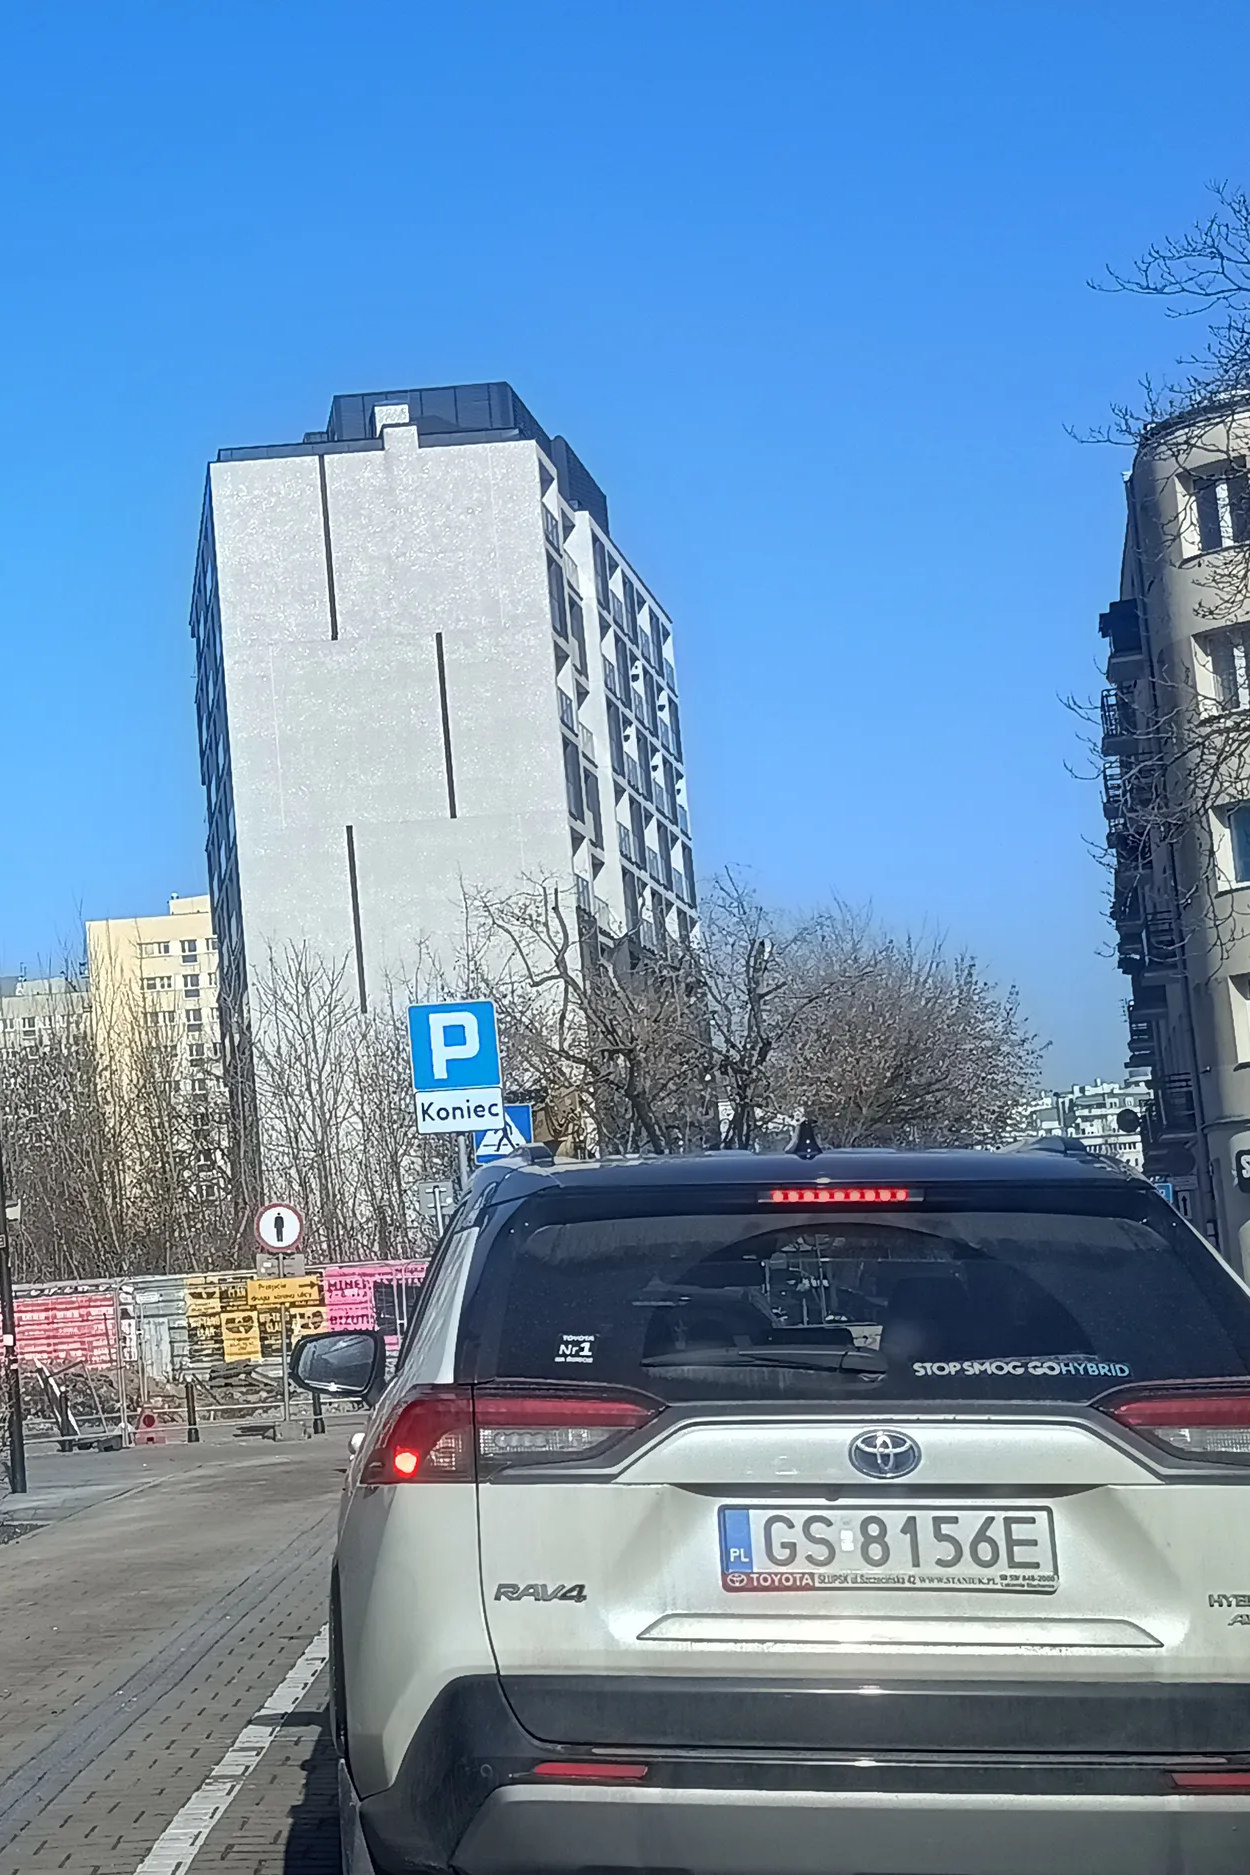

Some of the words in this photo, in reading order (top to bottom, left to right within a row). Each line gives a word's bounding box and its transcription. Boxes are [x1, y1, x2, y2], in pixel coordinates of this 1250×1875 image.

[428, 1011, 480, 1080] P
[420, 1099, 500, 1122] Koniec
[912, 1361, 960, 1377] STOP
[964, 1360, 1025, 1376] SMOG
[763, 1514, 836, 1568] GS
[859, 1515, 1041, 1570] 8156E
[729, 1548, 750, 1563] PL
[750, 1573, 813, 1588] TOYOTA
[493, 1583, 588, 1603] RAV4
